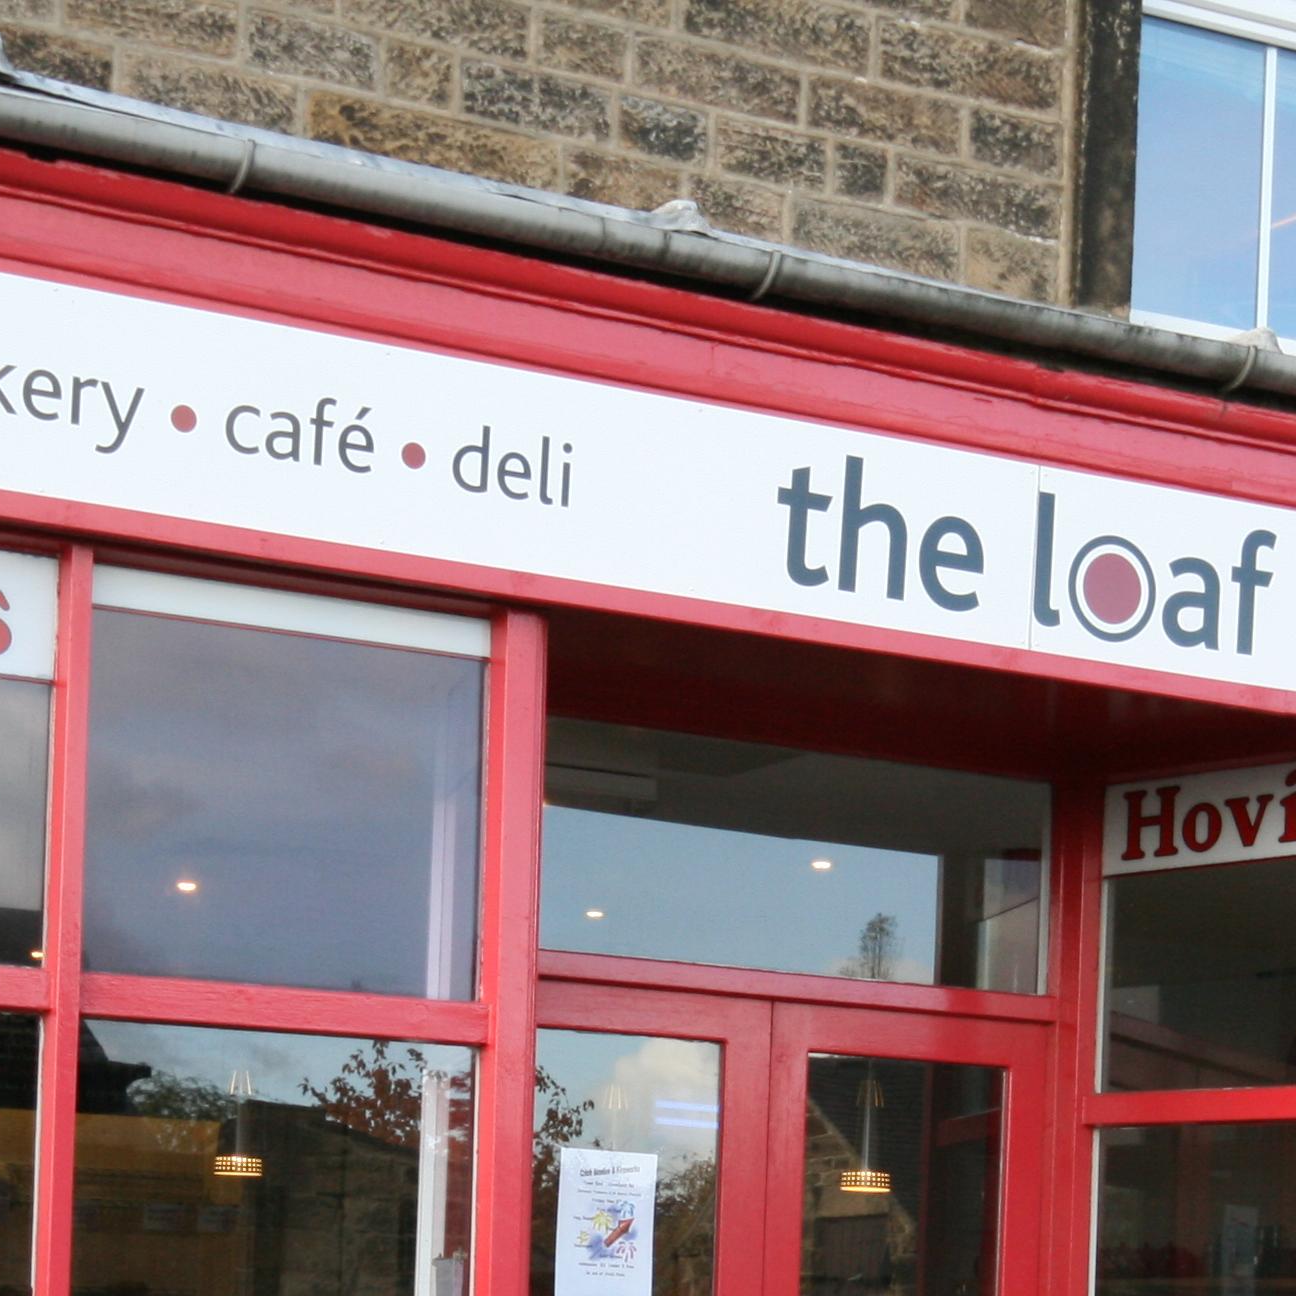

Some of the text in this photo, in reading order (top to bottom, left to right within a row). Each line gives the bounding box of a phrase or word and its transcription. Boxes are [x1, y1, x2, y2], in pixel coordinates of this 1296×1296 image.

[225, 397, 375, 474] café
[452, 425, 574, 508] deli
[777, 455, 1277, 655] the loaf
